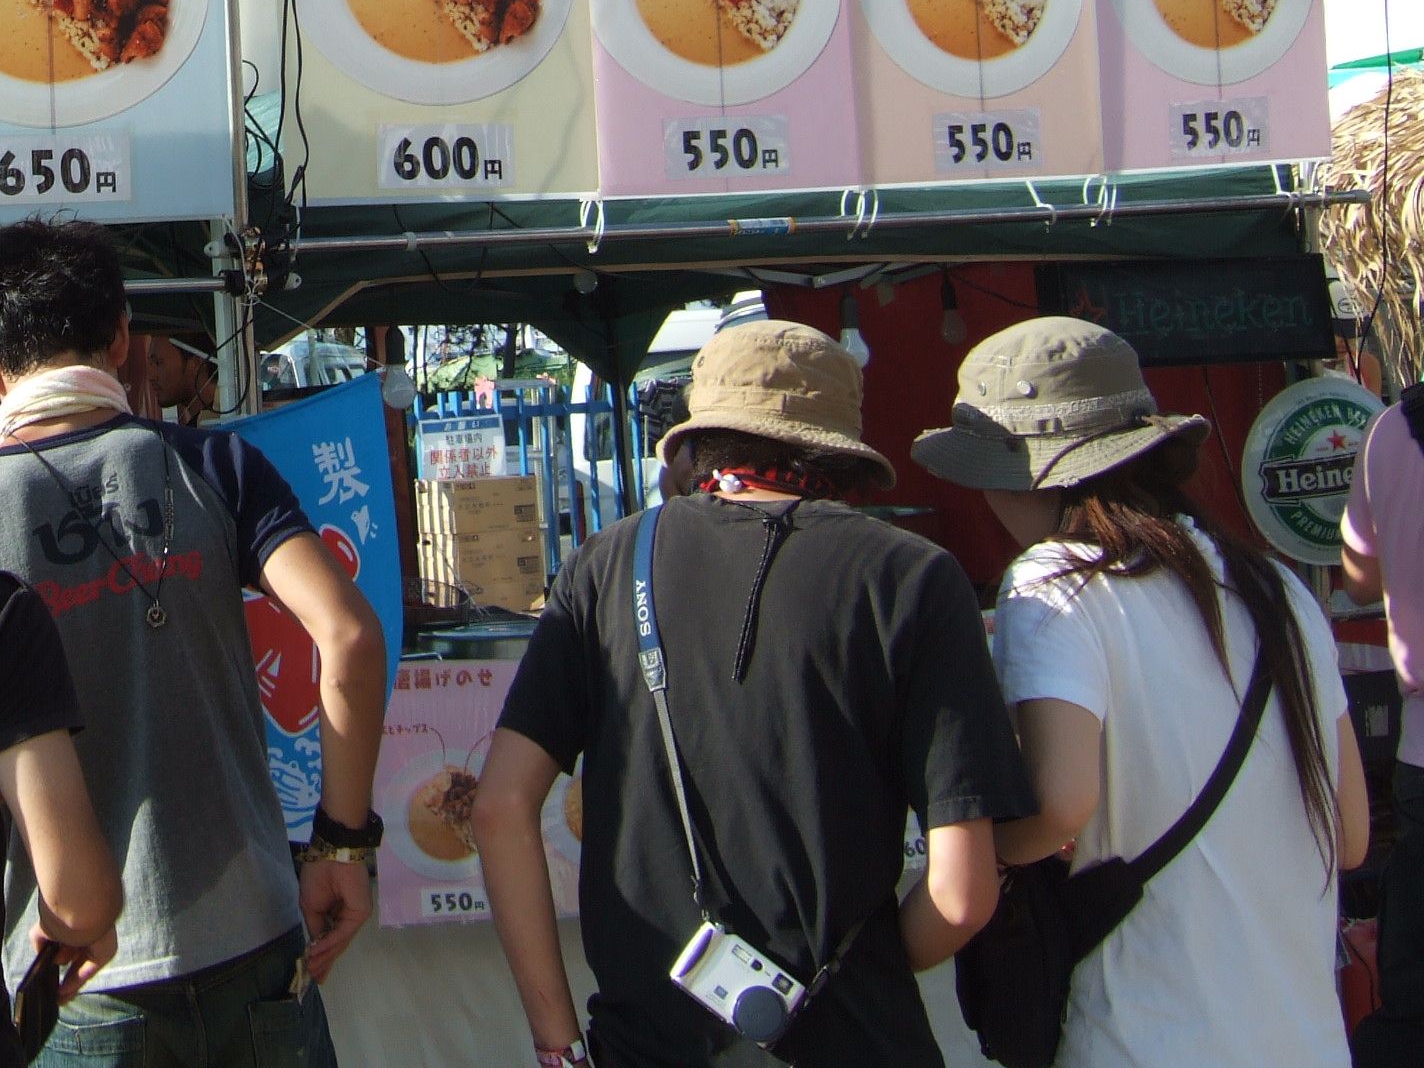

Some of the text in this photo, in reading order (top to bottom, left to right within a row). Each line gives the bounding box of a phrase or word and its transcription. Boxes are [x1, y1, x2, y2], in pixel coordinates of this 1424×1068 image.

[681, 128, 780, 172] 550円
[947, 121, 1033, 164] 550円
[1181, 110, 1262, 151] 550円
[393, 136, 503, 181] 600円
[1276, 464, 1354, 494] Heine
[1290, 511, 1342, 541] PREMIU
[635, 579, 652, 638] SONY
